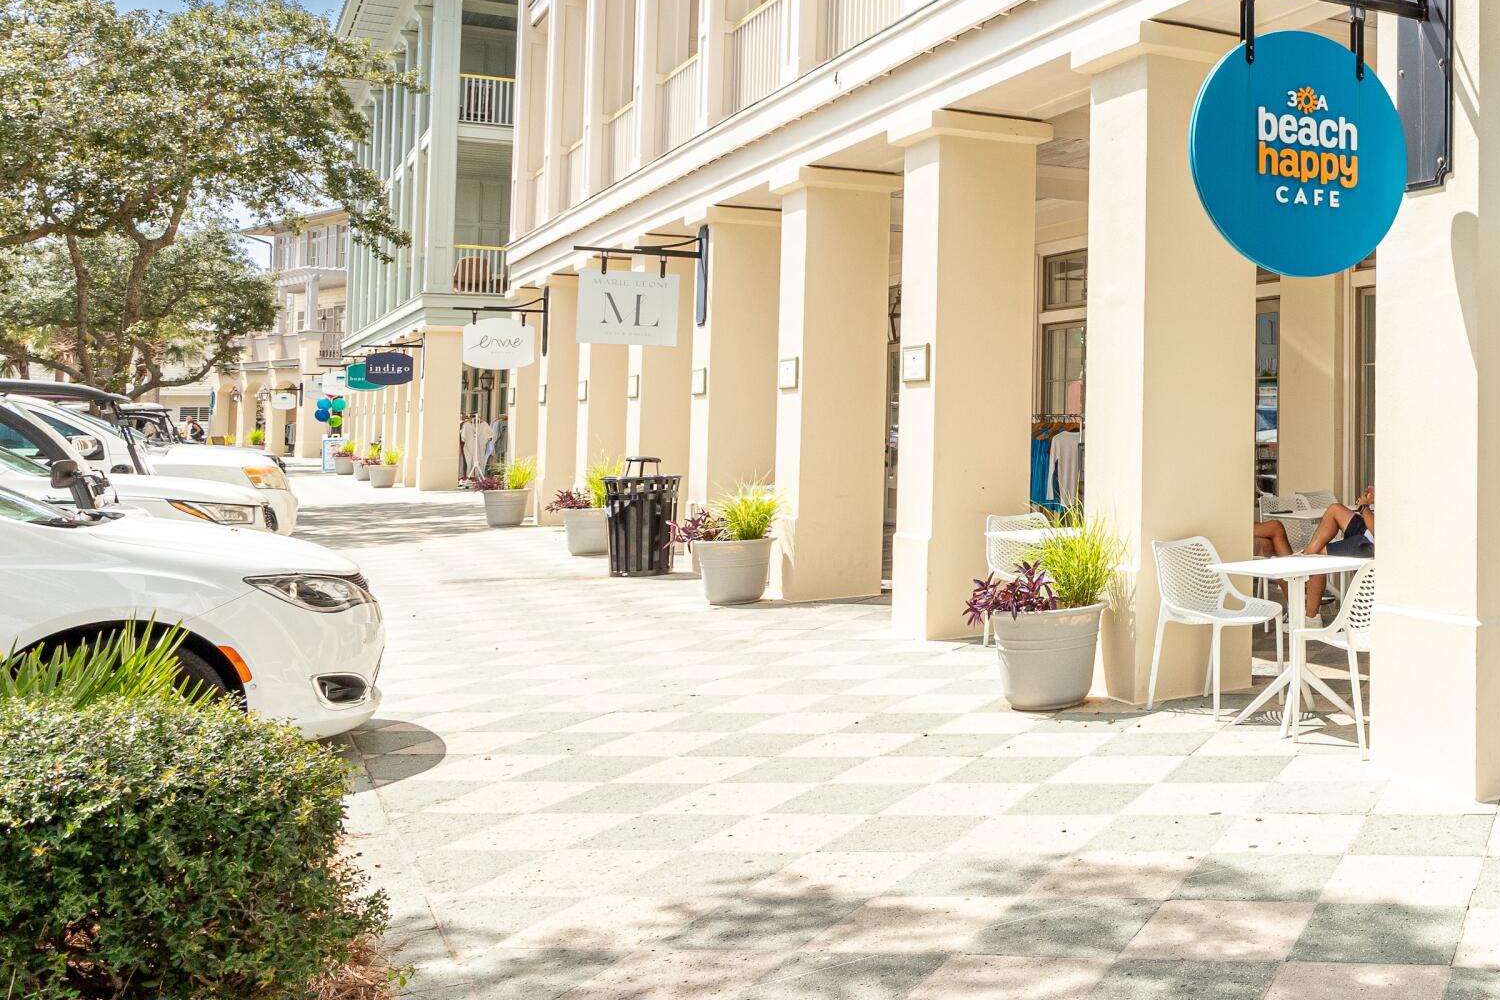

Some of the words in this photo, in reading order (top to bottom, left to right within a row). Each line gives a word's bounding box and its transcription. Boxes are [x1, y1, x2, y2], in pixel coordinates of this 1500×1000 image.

[1258, 106, 1358, 151] beach
[1258, 141, 1358, 188] happy
[1276, 186, 1340, 208] CAFE
[600, 292, 659, 327] ML
[467, 335, 523, 349] envie
[369, 363, 410, 374] indigo
